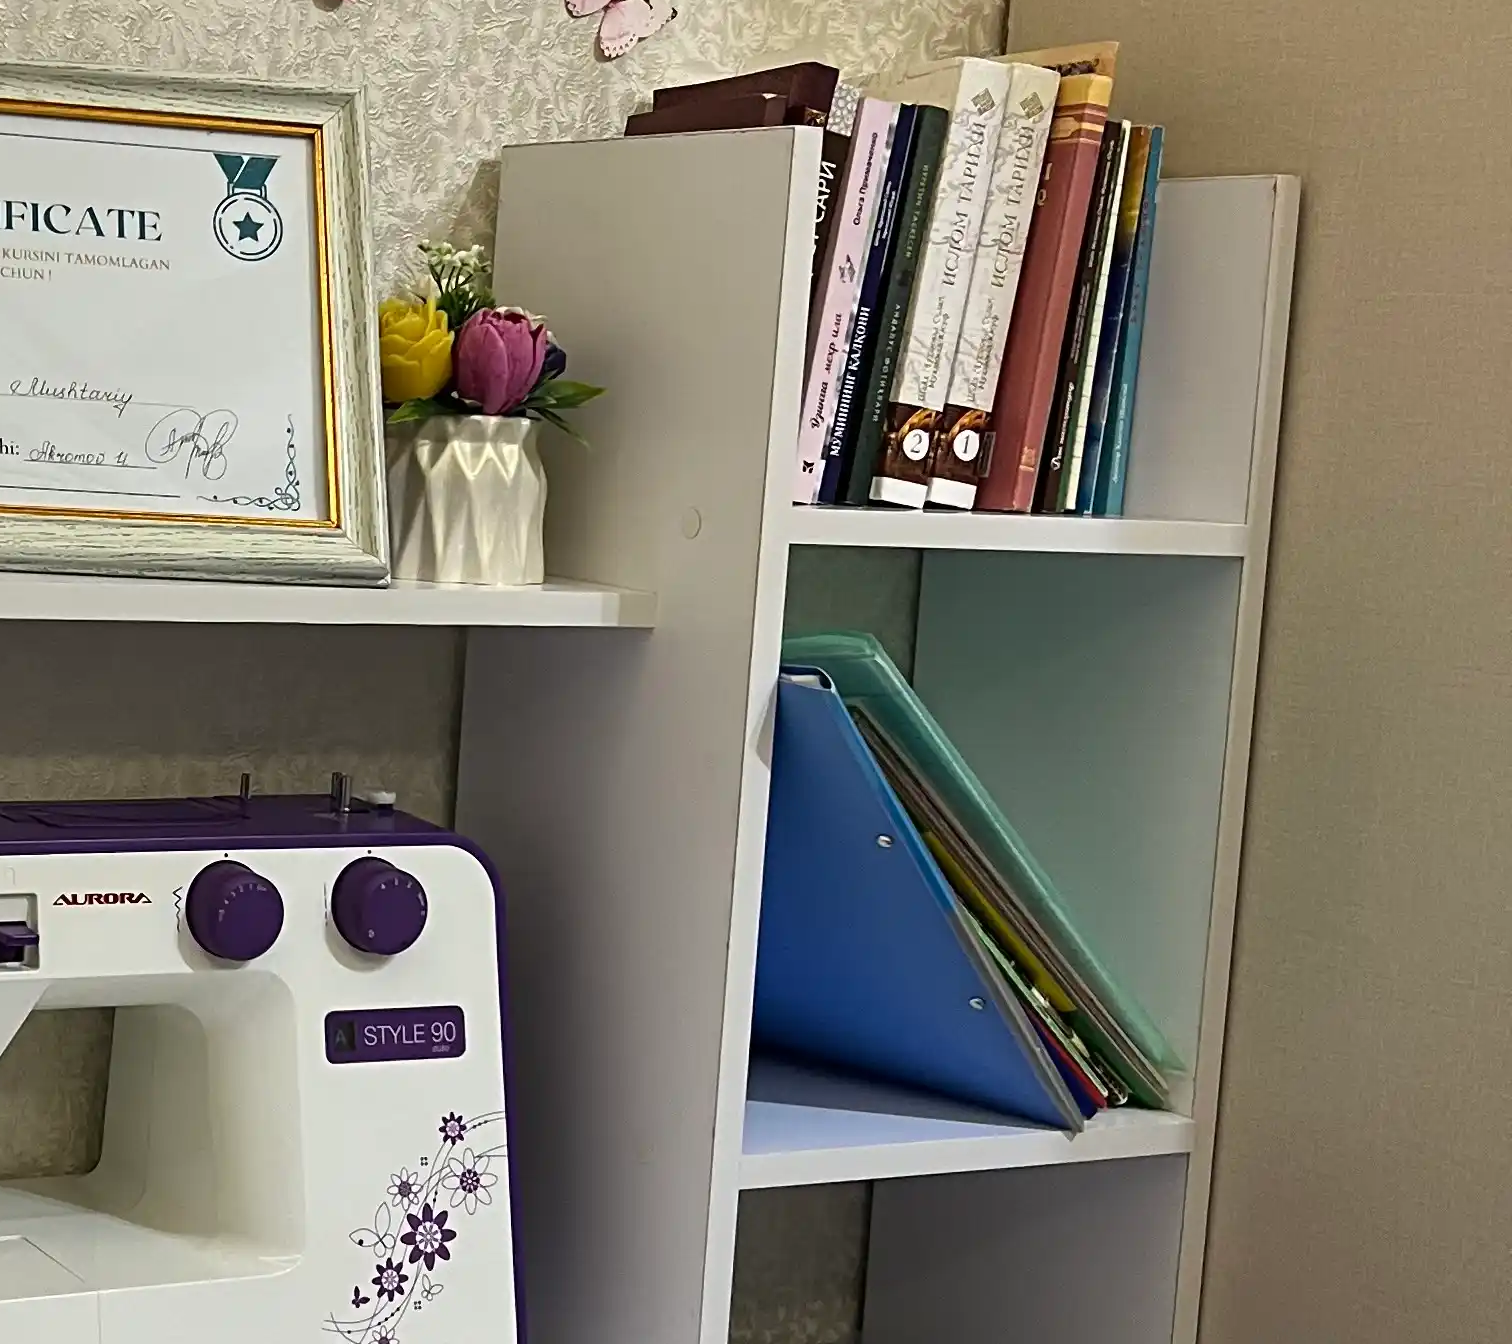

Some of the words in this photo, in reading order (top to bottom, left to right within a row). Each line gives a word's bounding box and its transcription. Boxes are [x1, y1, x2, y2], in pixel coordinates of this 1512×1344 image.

[3, 247, 60, 263] KURSINI
[64, 253, 170, 271] TAMOMLAGAN
[942, 211, 968, 286] ИСЛОМ
[991, 214, 1017, 288] ИСЛОМ
[910, 434, 922, 454] 2
[963, 435, 970, 454] 1
[53, 893, 152, 906] AURORA
[364, 1024, 425, 1046] STYLE
[431, 1021, 456, 1043] 90
